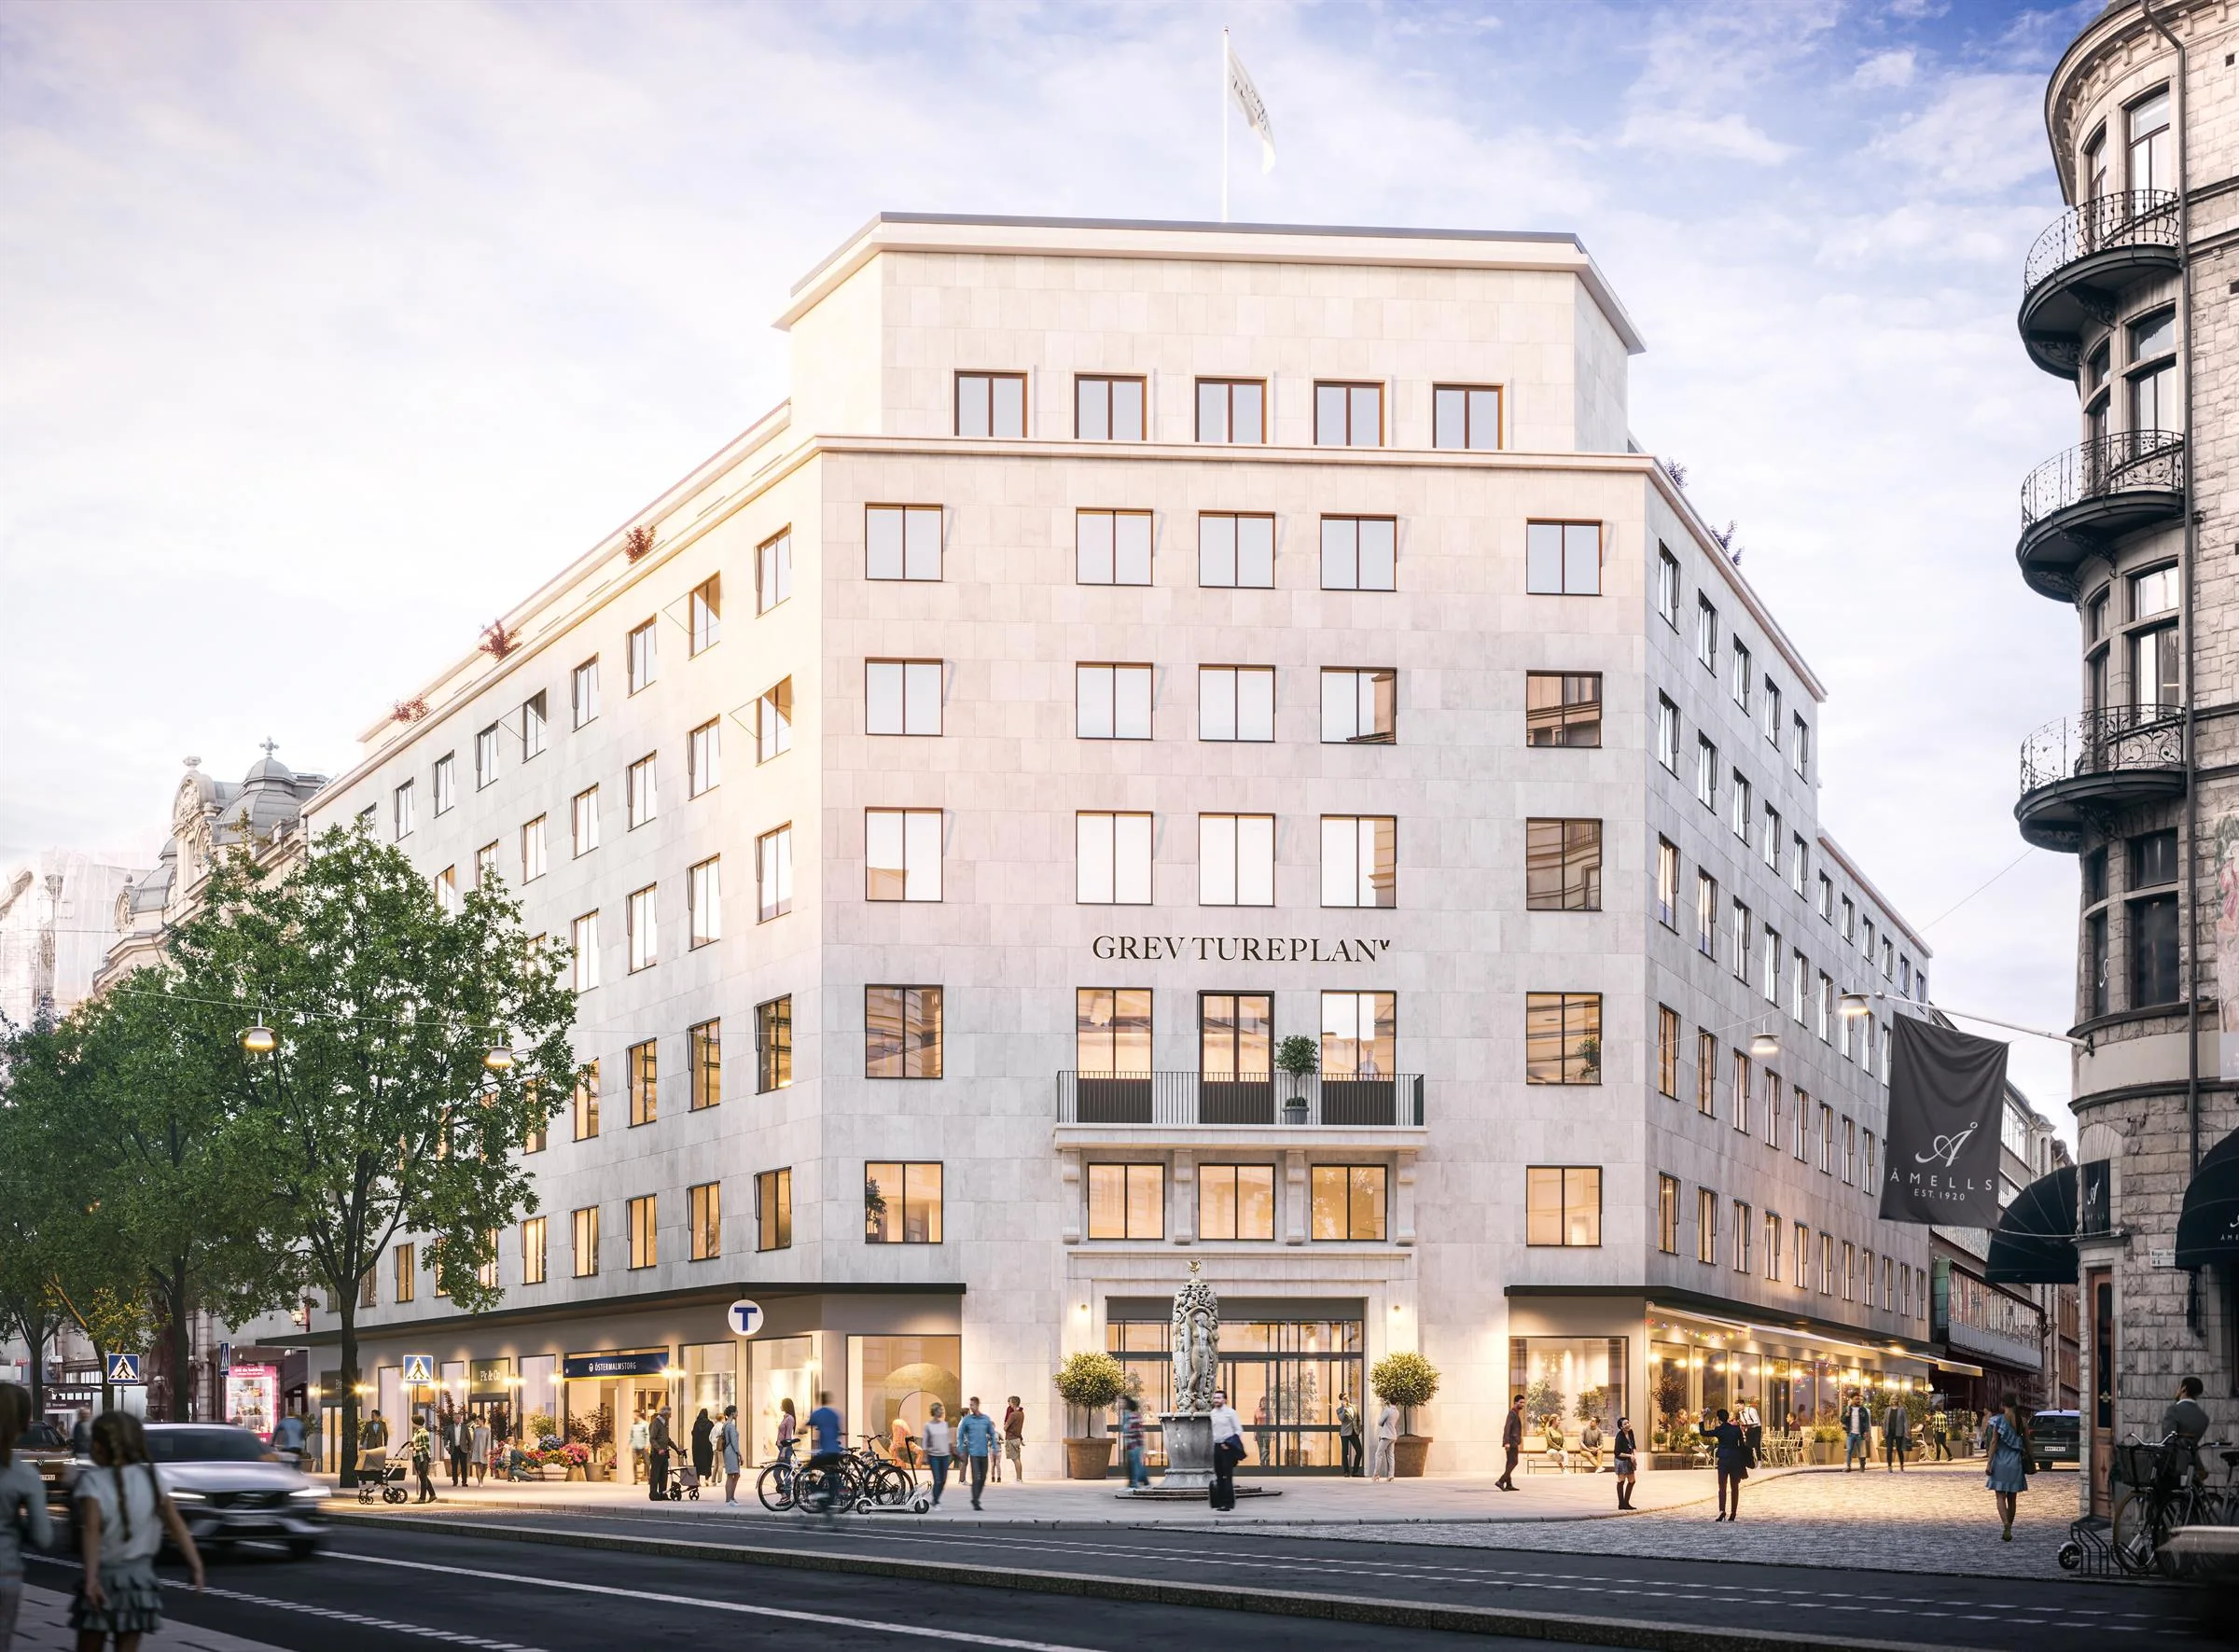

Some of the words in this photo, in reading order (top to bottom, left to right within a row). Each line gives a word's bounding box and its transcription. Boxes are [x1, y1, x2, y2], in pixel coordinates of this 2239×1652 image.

[1092, 935, 1186, 960] GREV
[1890, 1167, 1993, 1191] ÅMELLS
[1940, 1192, 1966, 1201] 1920
[734, 1307, 758, 1331] T
[594, 1361, 637, 1371] ÖSTERMALMSTORG
